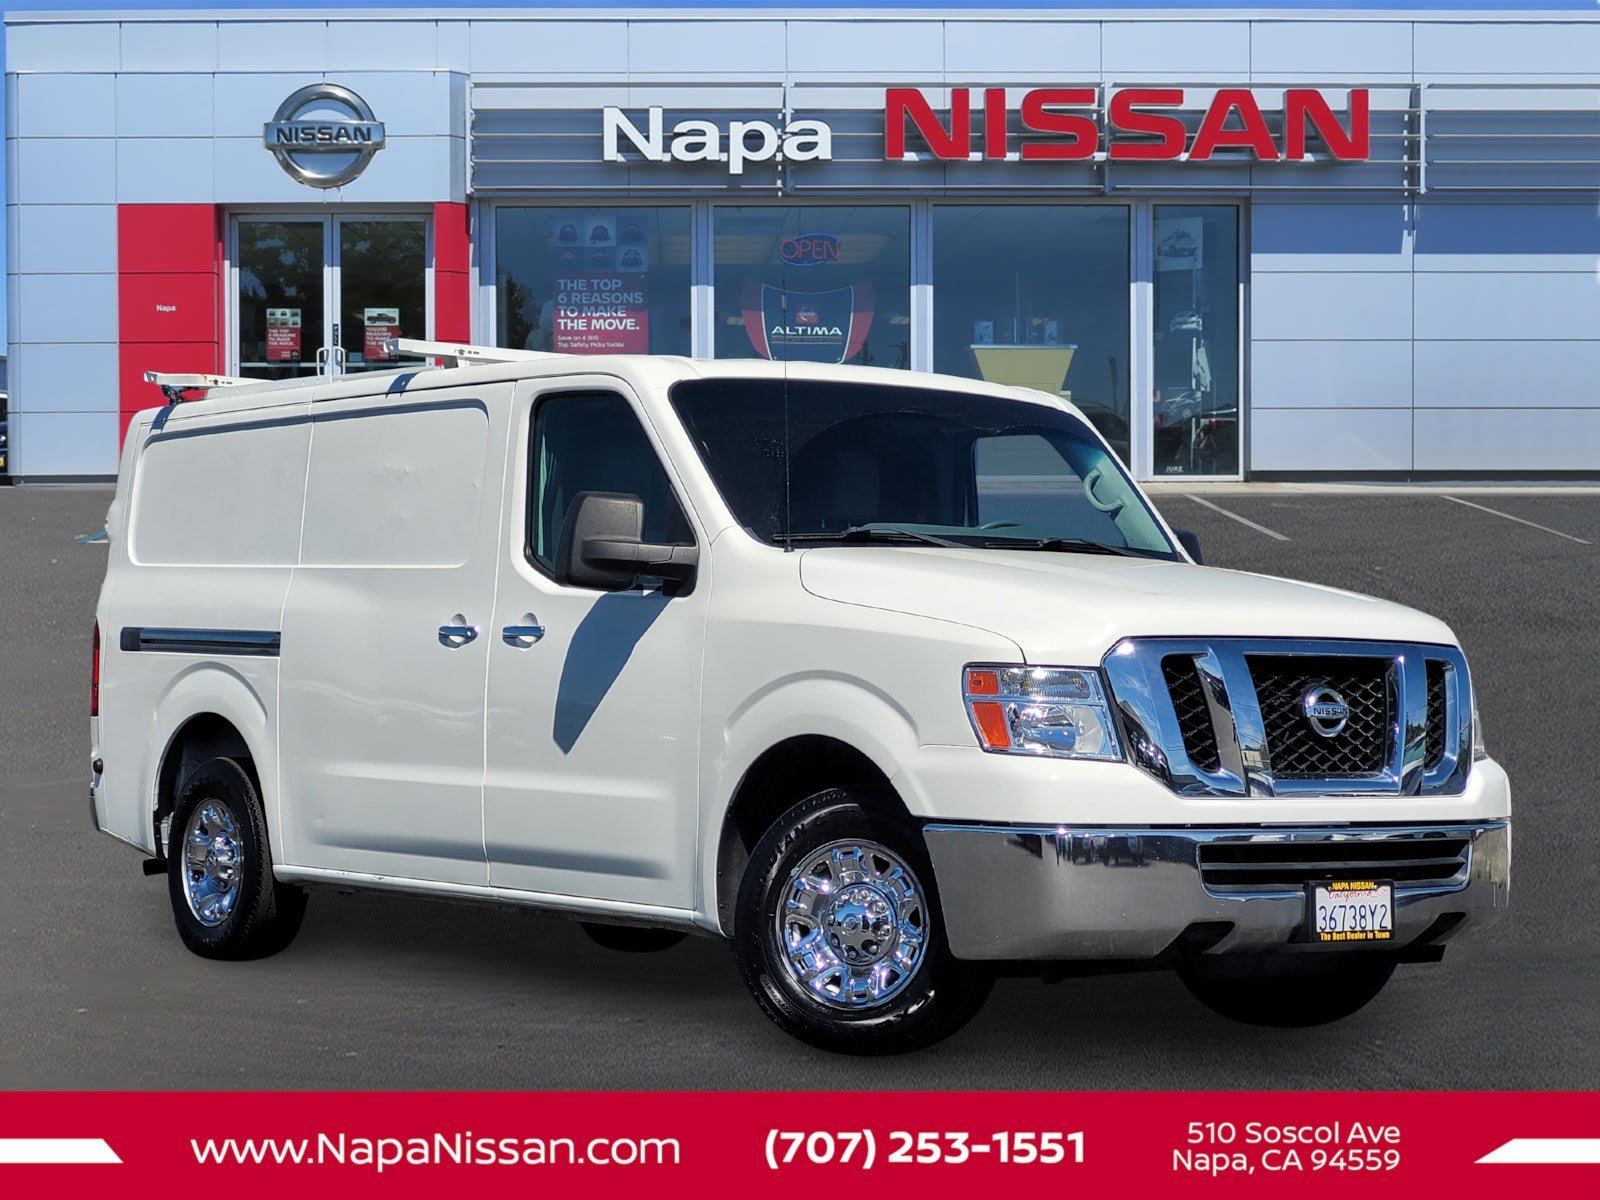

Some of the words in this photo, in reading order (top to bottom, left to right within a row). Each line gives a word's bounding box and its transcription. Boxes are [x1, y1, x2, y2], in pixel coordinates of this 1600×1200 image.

[276, 126, 371, 142] NISSAN
[603, 106, 832, 174] Napa
[884, 87, 1370, 162] NISSAN
[781, 240, 841, 260] OPEN
[557, 279, 587, 291] THE
[591, 279, 622, 291] TOP
[558, 292, 567, 304] 6
[572, 292, 643, 304] REASONS
[156, 304, 176, 312] Napa
[557, 306, 578, 317] TO
[582, 306, 626, 317] MAKE
[557, 319, 587, 330] THE
[591, 319, 640, 330] MOVE.
[771, 326, 842, 335] ALTIMA
[1313, 707, 1348, 716] NISSAN
[1332, 882, 1349, 890] NAPA
[1350, 881, 1375, 890] NISSAN
[1319, 904, 1388, 931] 36738Y2
[1321, 932, 1331, 941] The
[1333, 932, 1345, 940] Best
[1347, 931, 1366, 940] Dealer
[1368, 931, 1374, 939] in
[1375, 930, 1390, 939] Town
